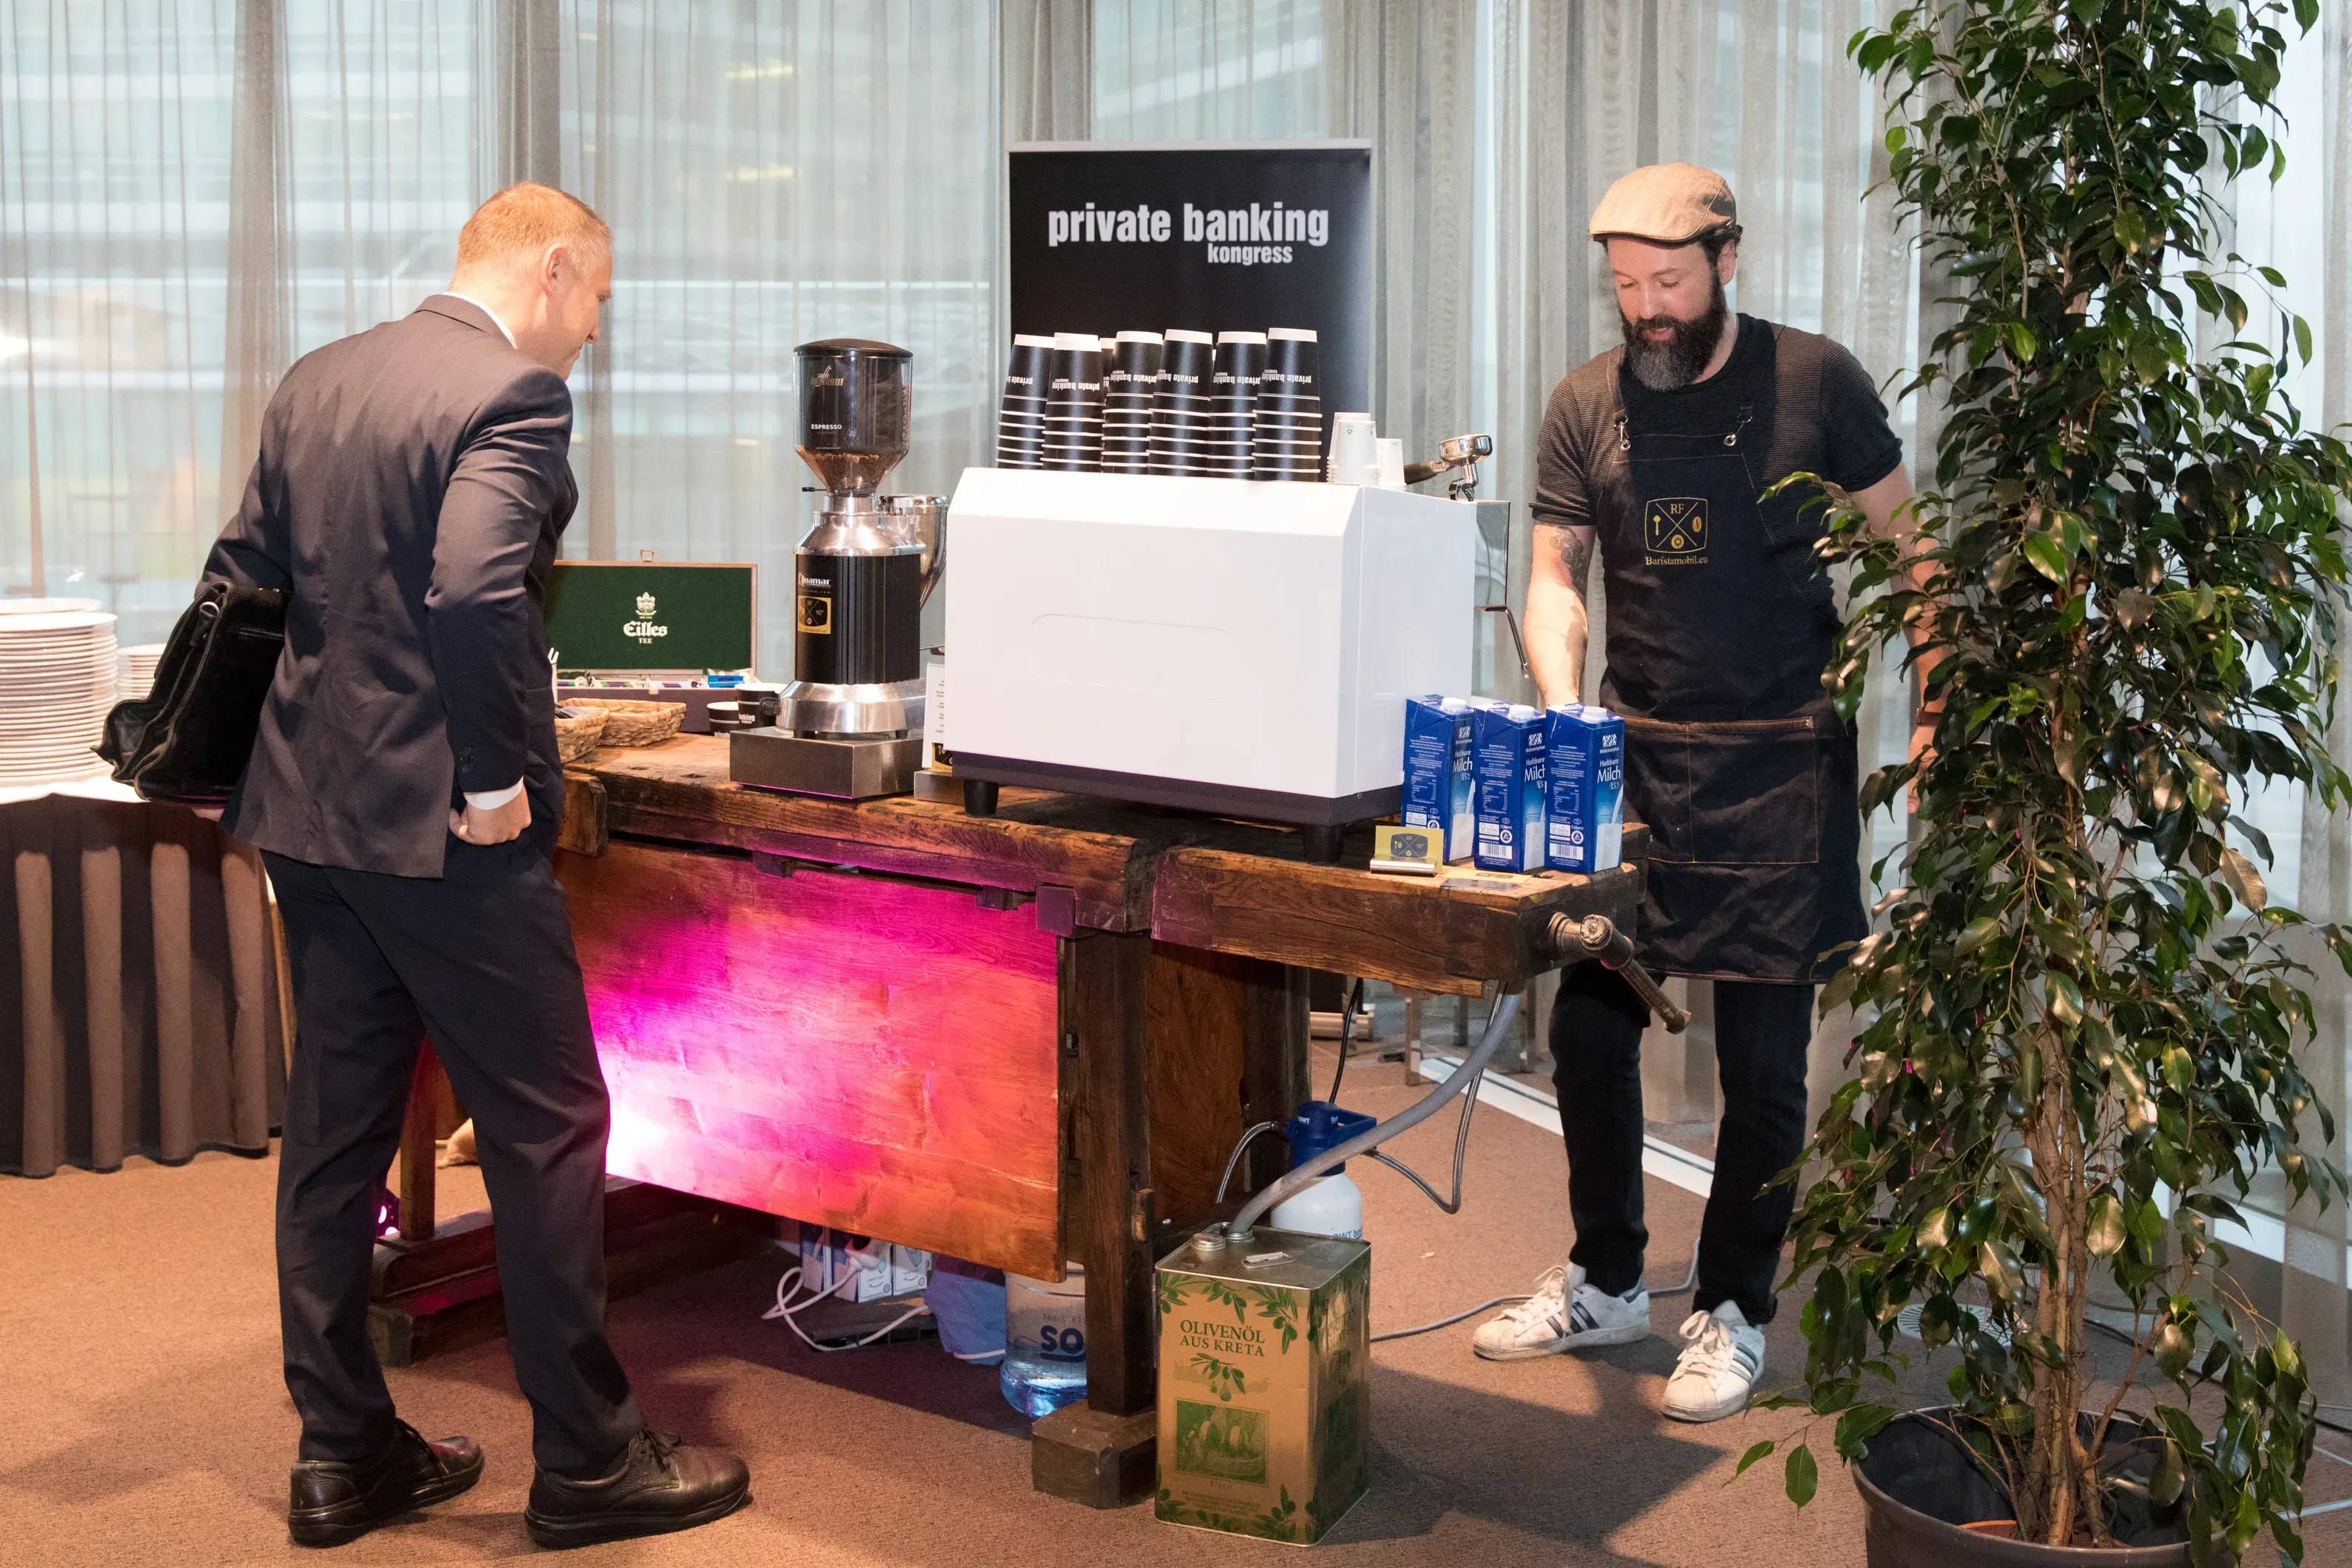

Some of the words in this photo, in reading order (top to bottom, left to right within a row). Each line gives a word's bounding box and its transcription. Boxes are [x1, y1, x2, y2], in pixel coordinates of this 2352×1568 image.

[1049, 202, 1171, 247] private
[1184, 201, 1328, 246] banking
[1207, 243, 1293, 266] kongress
[1011, 376, 1033, 385] private
[1133, 374, 1156, 384] private
[1173, 374, 1198, 384] private
[1261, 372, 1285, 382] banking
[1286, 375, 1311, 384] private
[1052, 381, 1076, 390] banking
[1078, 382, 1100, 392] private
[1670, 504, 1685, 514] RF
[1645, 555, 1708, 566] Baristamobil.eu
[798, 573, 831, 586] Quamar
[623, 621, 667, 636] Eilles
[1452, 757, 1473, 774] Milch
[1600, 759, 1619, 767] Haltbare
[1597, 766, 1621, 783] Milch
[1180, 1319, 1266, 1344] OLIVENÖL
[1180, 1335, 1210, 1349] AUS
[1214, 1339, 1265, 1357] KRETA
